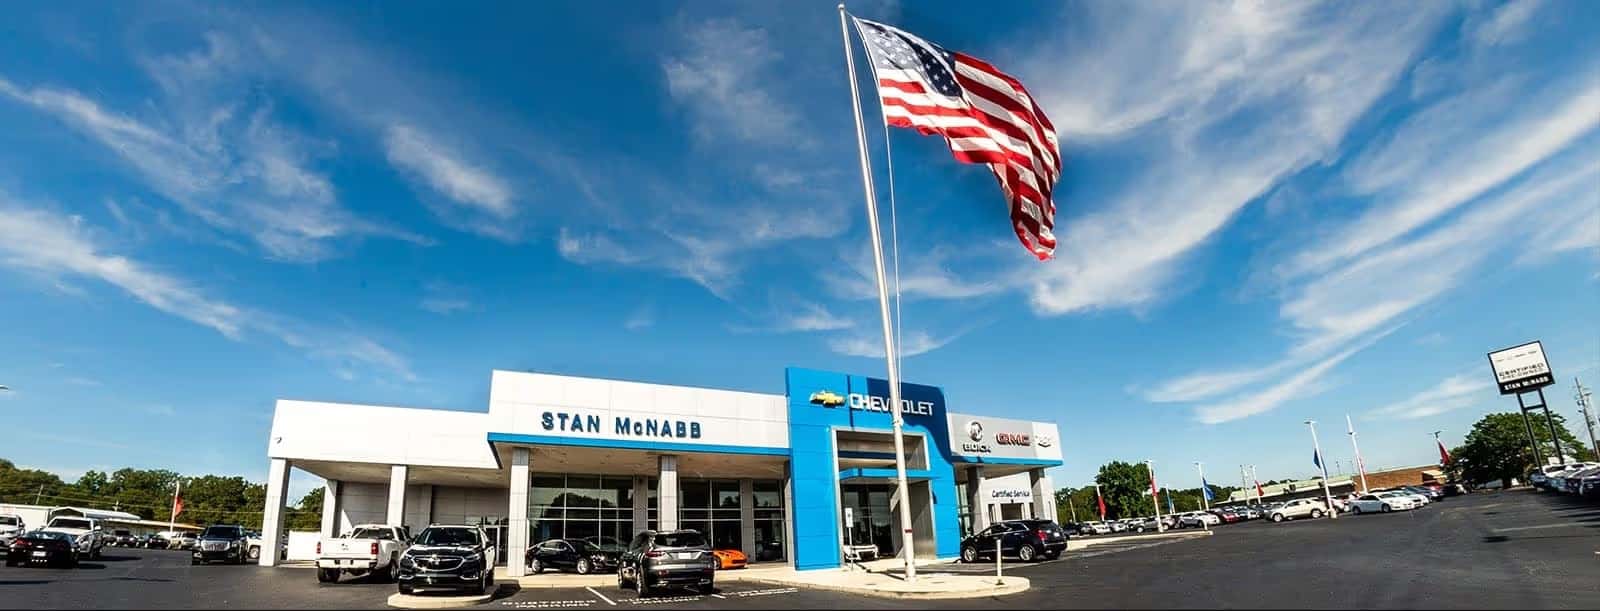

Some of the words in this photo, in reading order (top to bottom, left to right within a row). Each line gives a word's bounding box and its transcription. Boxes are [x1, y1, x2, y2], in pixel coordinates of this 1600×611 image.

[849, 393, 934, 416] CHEVOLET
[541, 411, 600, 433] STAN
[615, 417, 702, 439] McNABB
[963, 443, 991, 453] BUICK
[995, 432, 1030, 446] GMC
